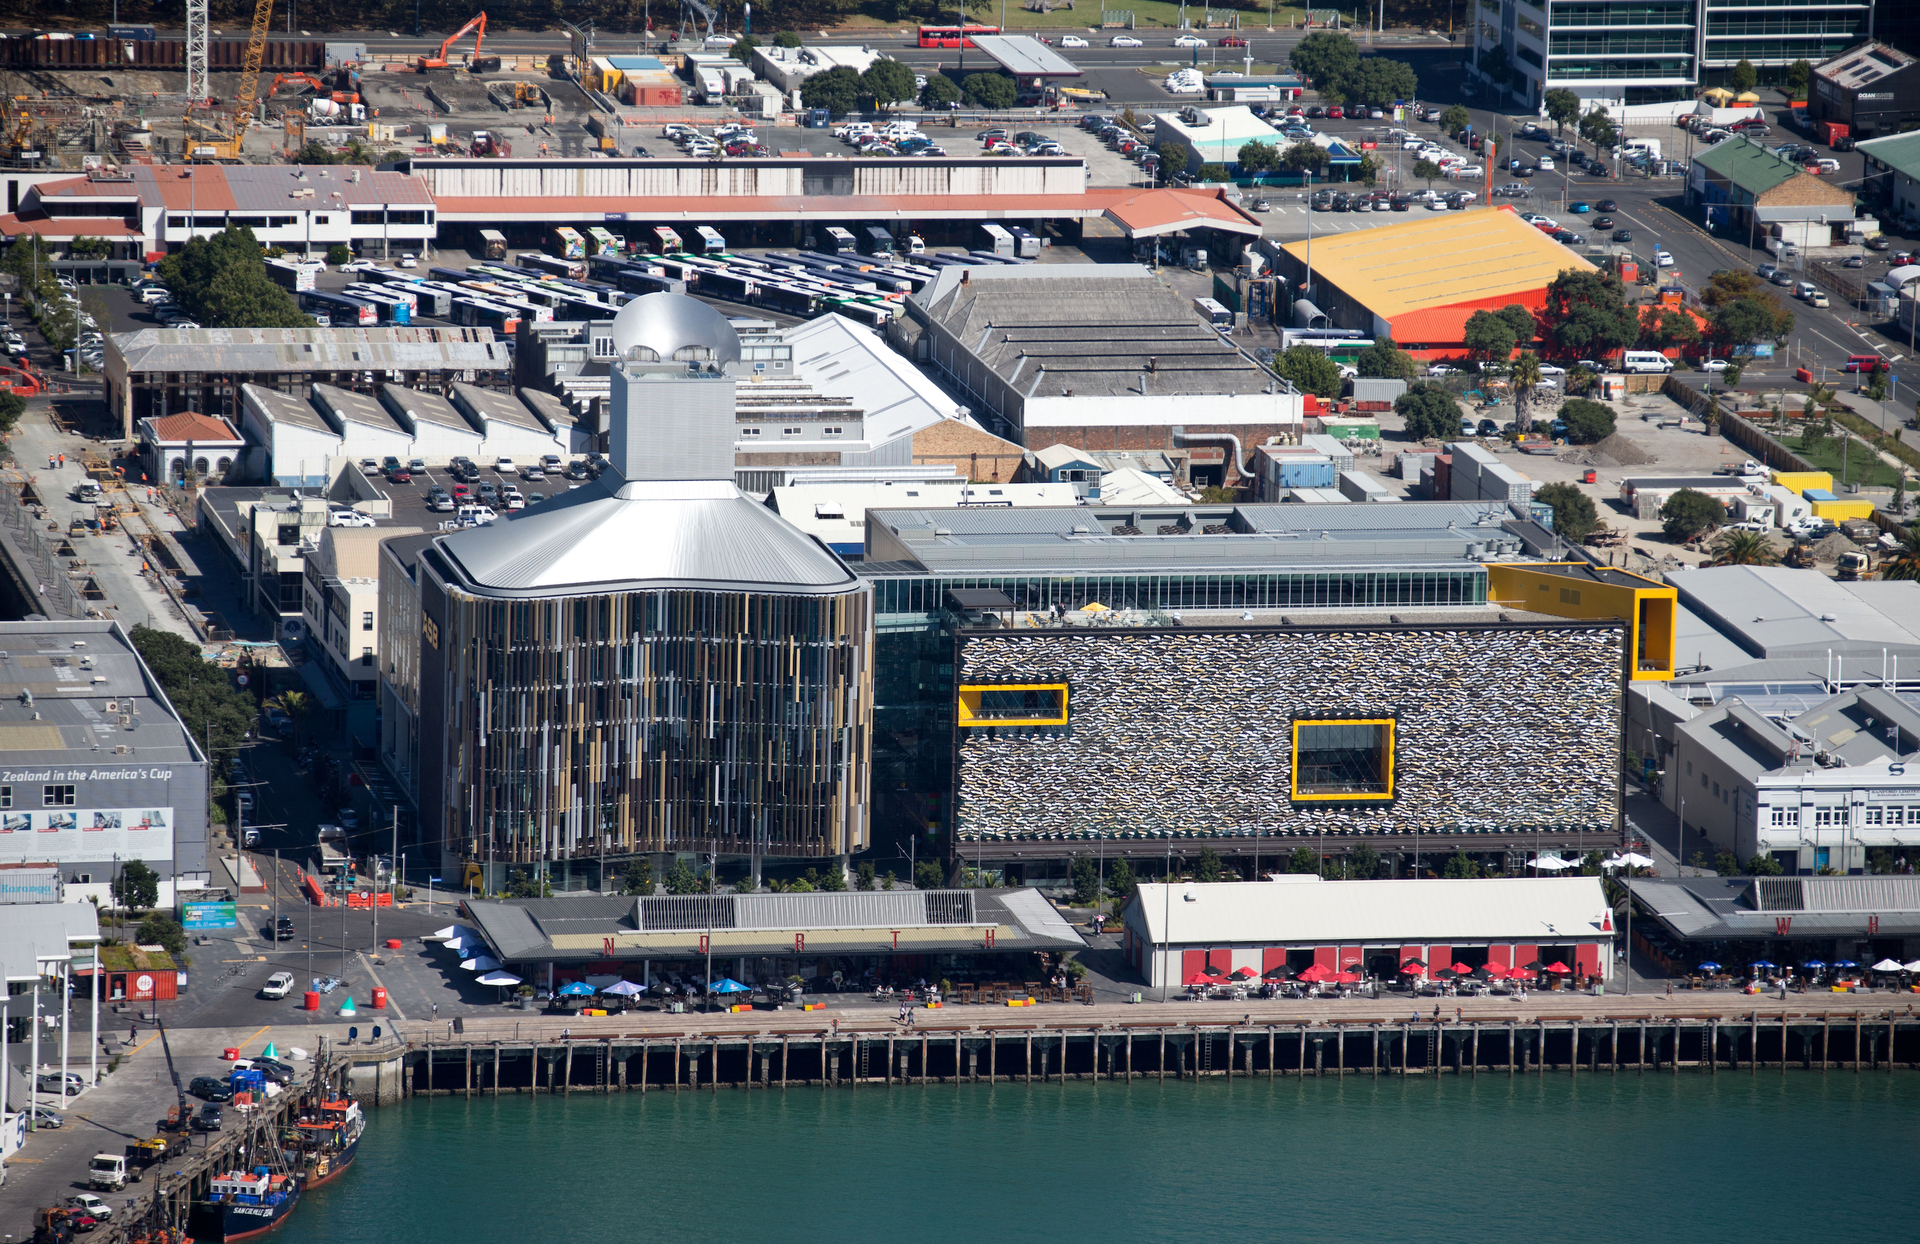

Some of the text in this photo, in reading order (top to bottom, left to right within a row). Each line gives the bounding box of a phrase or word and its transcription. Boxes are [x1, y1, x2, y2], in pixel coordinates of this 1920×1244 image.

[422, 609, 438, 650] ASB
[2, 768, 172, 782] Zealand in the America's Cup
[1, 884, 51, 895] Karanga
[16, 1112, 25, 1150] 5
